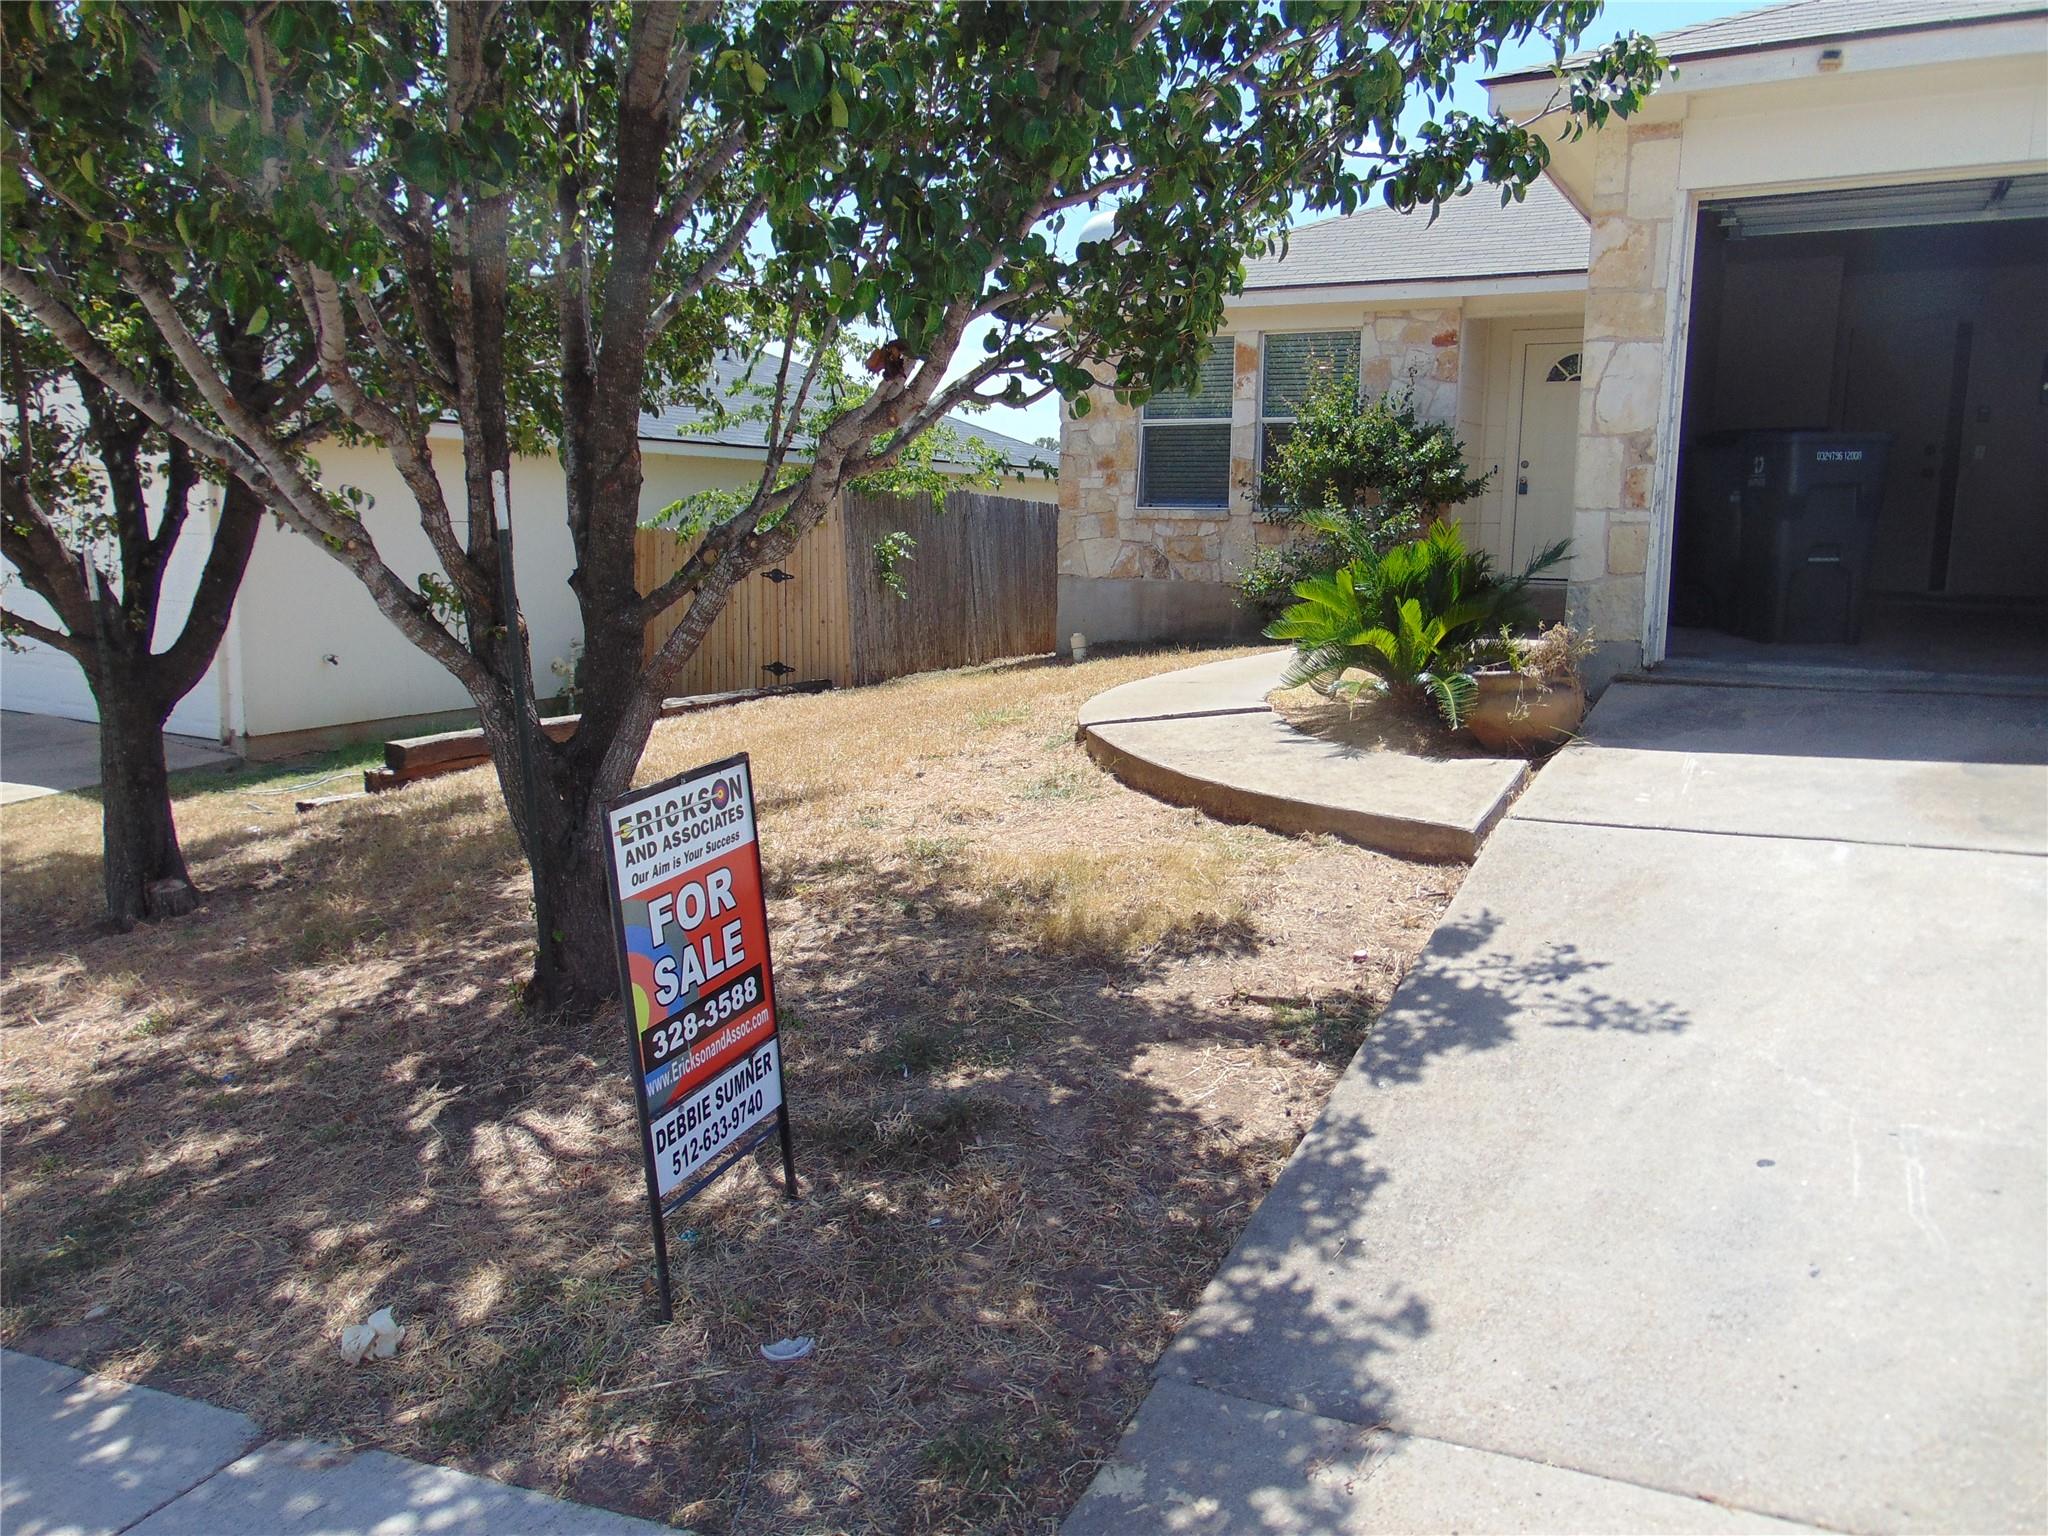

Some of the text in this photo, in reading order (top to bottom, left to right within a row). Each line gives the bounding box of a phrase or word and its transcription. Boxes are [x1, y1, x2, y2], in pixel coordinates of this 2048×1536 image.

[618, 774, 743, 846] ERICKSON
[625, 805, 744, 868] AND ASSOCIATES
[632, 831, 740, 887] Our Aim is Your Success
[648, 866, 737, 948] FOR
[654, 918, 745, 1006] SALE
[646, 1007, 770, 1097] www.EricksonandAssoc.com
[652, 976, 757, 1058] 328-3588
[655, 1051, 773, 1155] DEBBIE SUMNER
[672, 1089, 763, 1176] 512-633-9740
